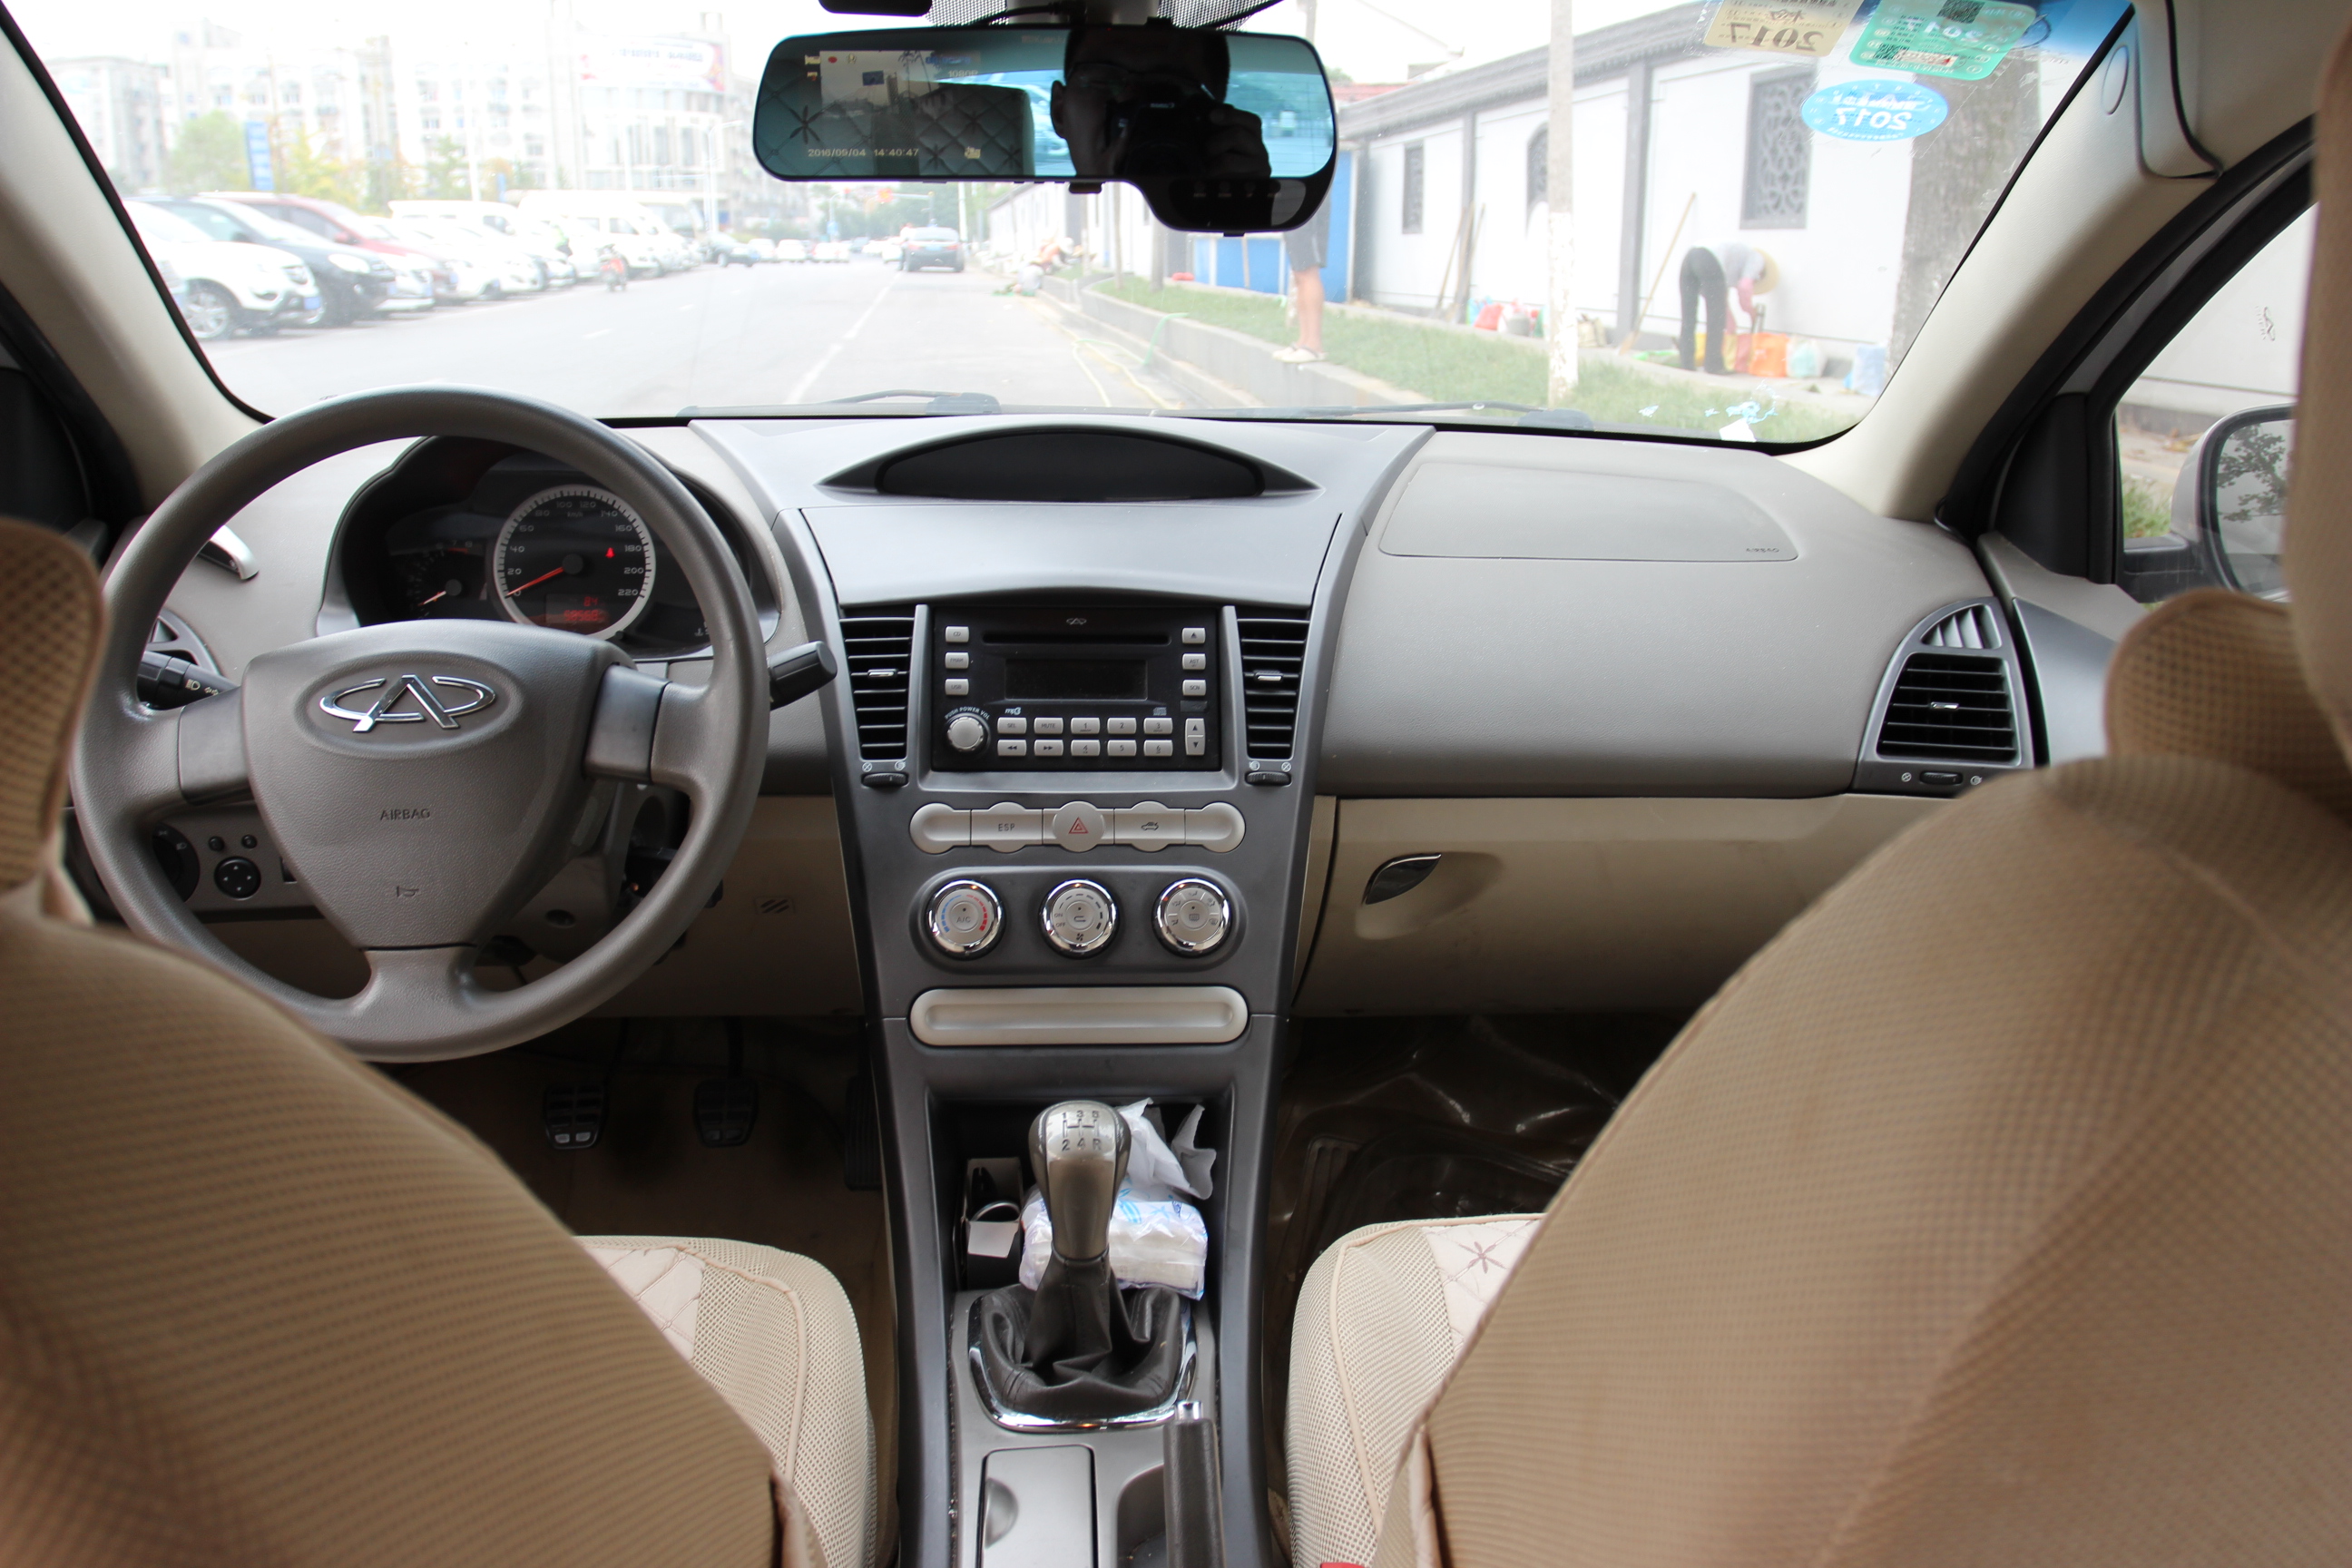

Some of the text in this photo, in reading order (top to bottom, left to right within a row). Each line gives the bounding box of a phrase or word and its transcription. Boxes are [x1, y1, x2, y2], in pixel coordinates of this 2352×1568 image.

[808, 148, 920, 158] 2016/09/04 14:40:47
[601, 510, 619, 518] 140
[615, 524, 633, 533] 160
[509, 545, 525, 554] 40
[624, 544, 642, 553] 180
[507, 567, 523, 575] 20
[623, 567, 644, 575] 200
[980, 710, 991, 720] VOL
[379, 808, 431, 821] AIRBAG
[998, 822, 1015, 832] ESP
[956, 916, 971, 924] A/C
[1076, 1110, 1084, 1118] 3
[1062, 1137, 1102, 1152] 2 4 R
